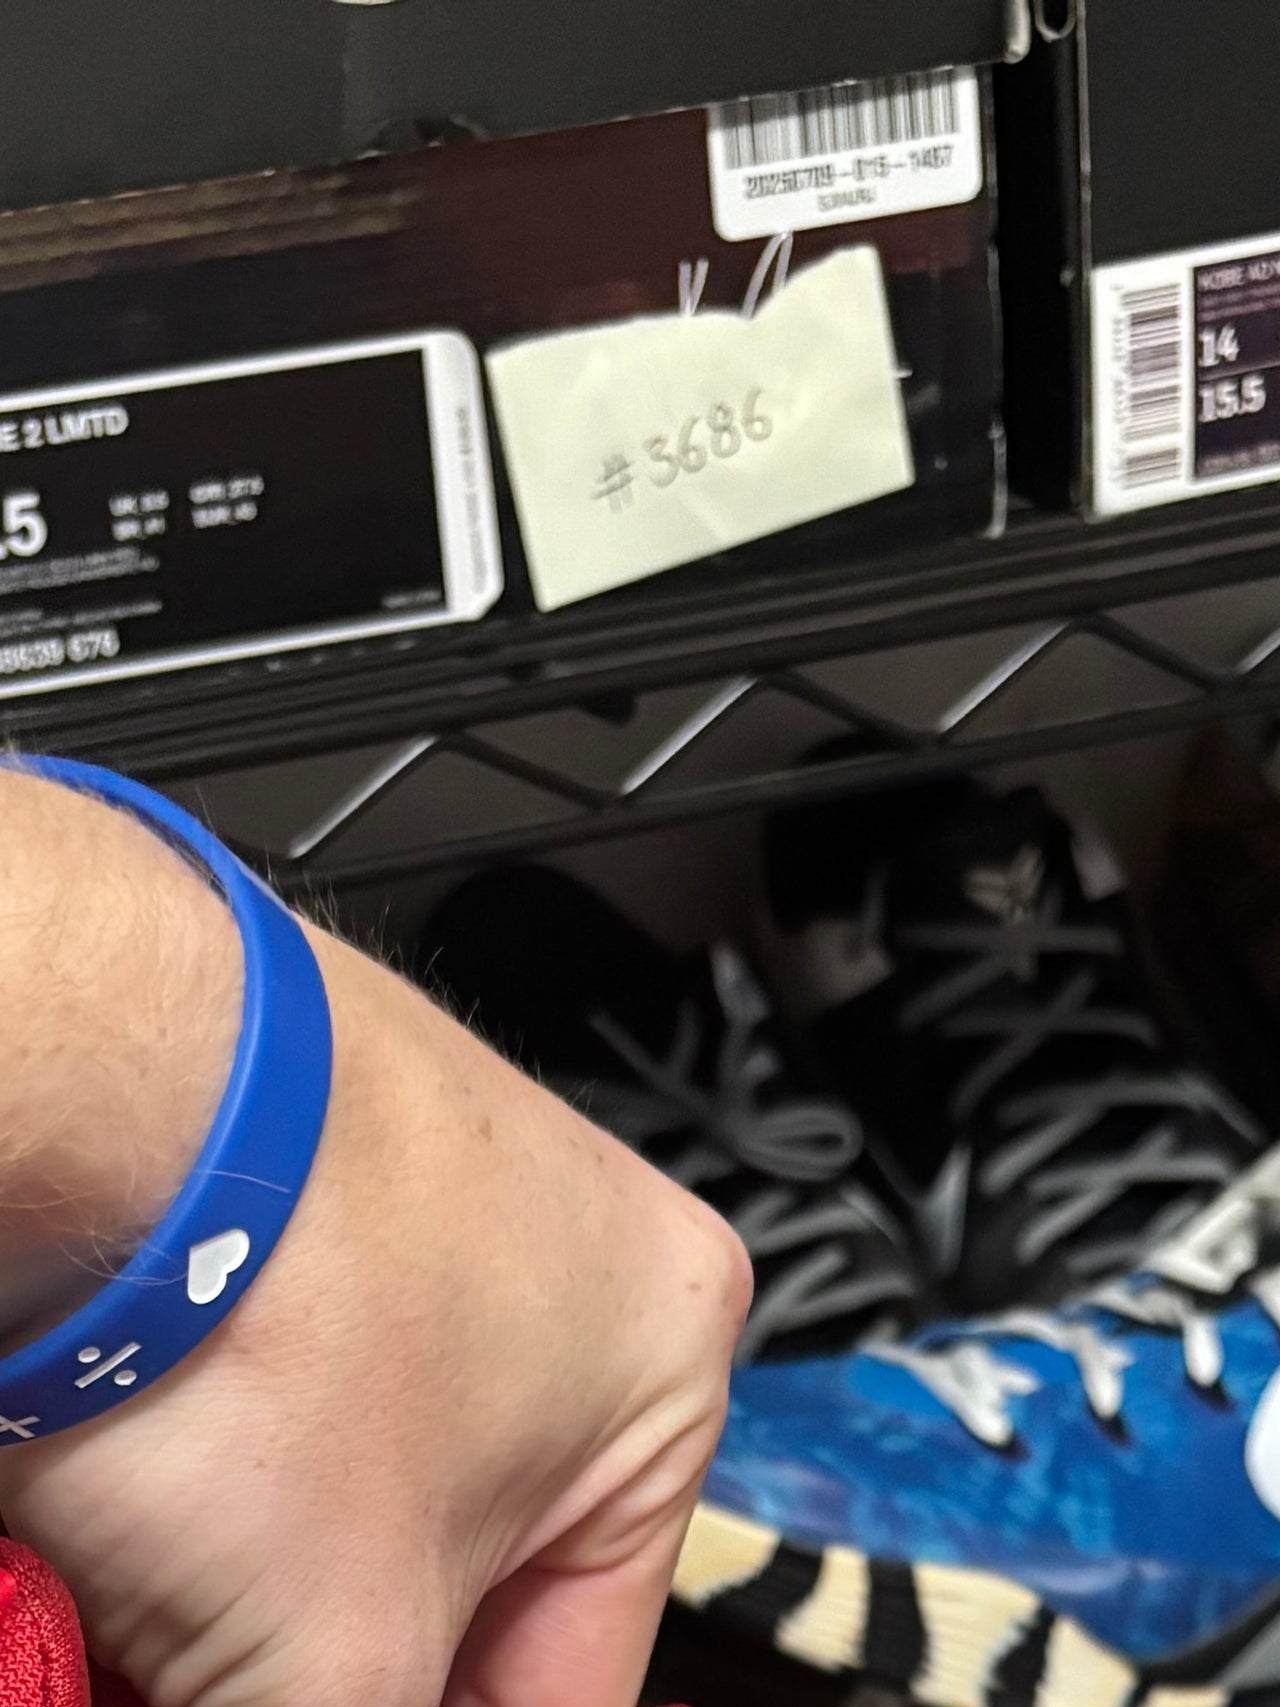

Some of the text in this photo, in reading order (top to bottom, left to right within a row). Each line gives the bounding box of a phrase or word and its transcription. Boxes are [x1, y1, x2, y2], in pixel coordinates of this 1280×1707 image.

[1197, 321, 1241, 368] 14
[1196, 371, 1267, 423] 15.5
[21, 416, 45, 449] 2
[44, 403, 130, 446] LMTD
[589, 385, 774, 513] #3686
